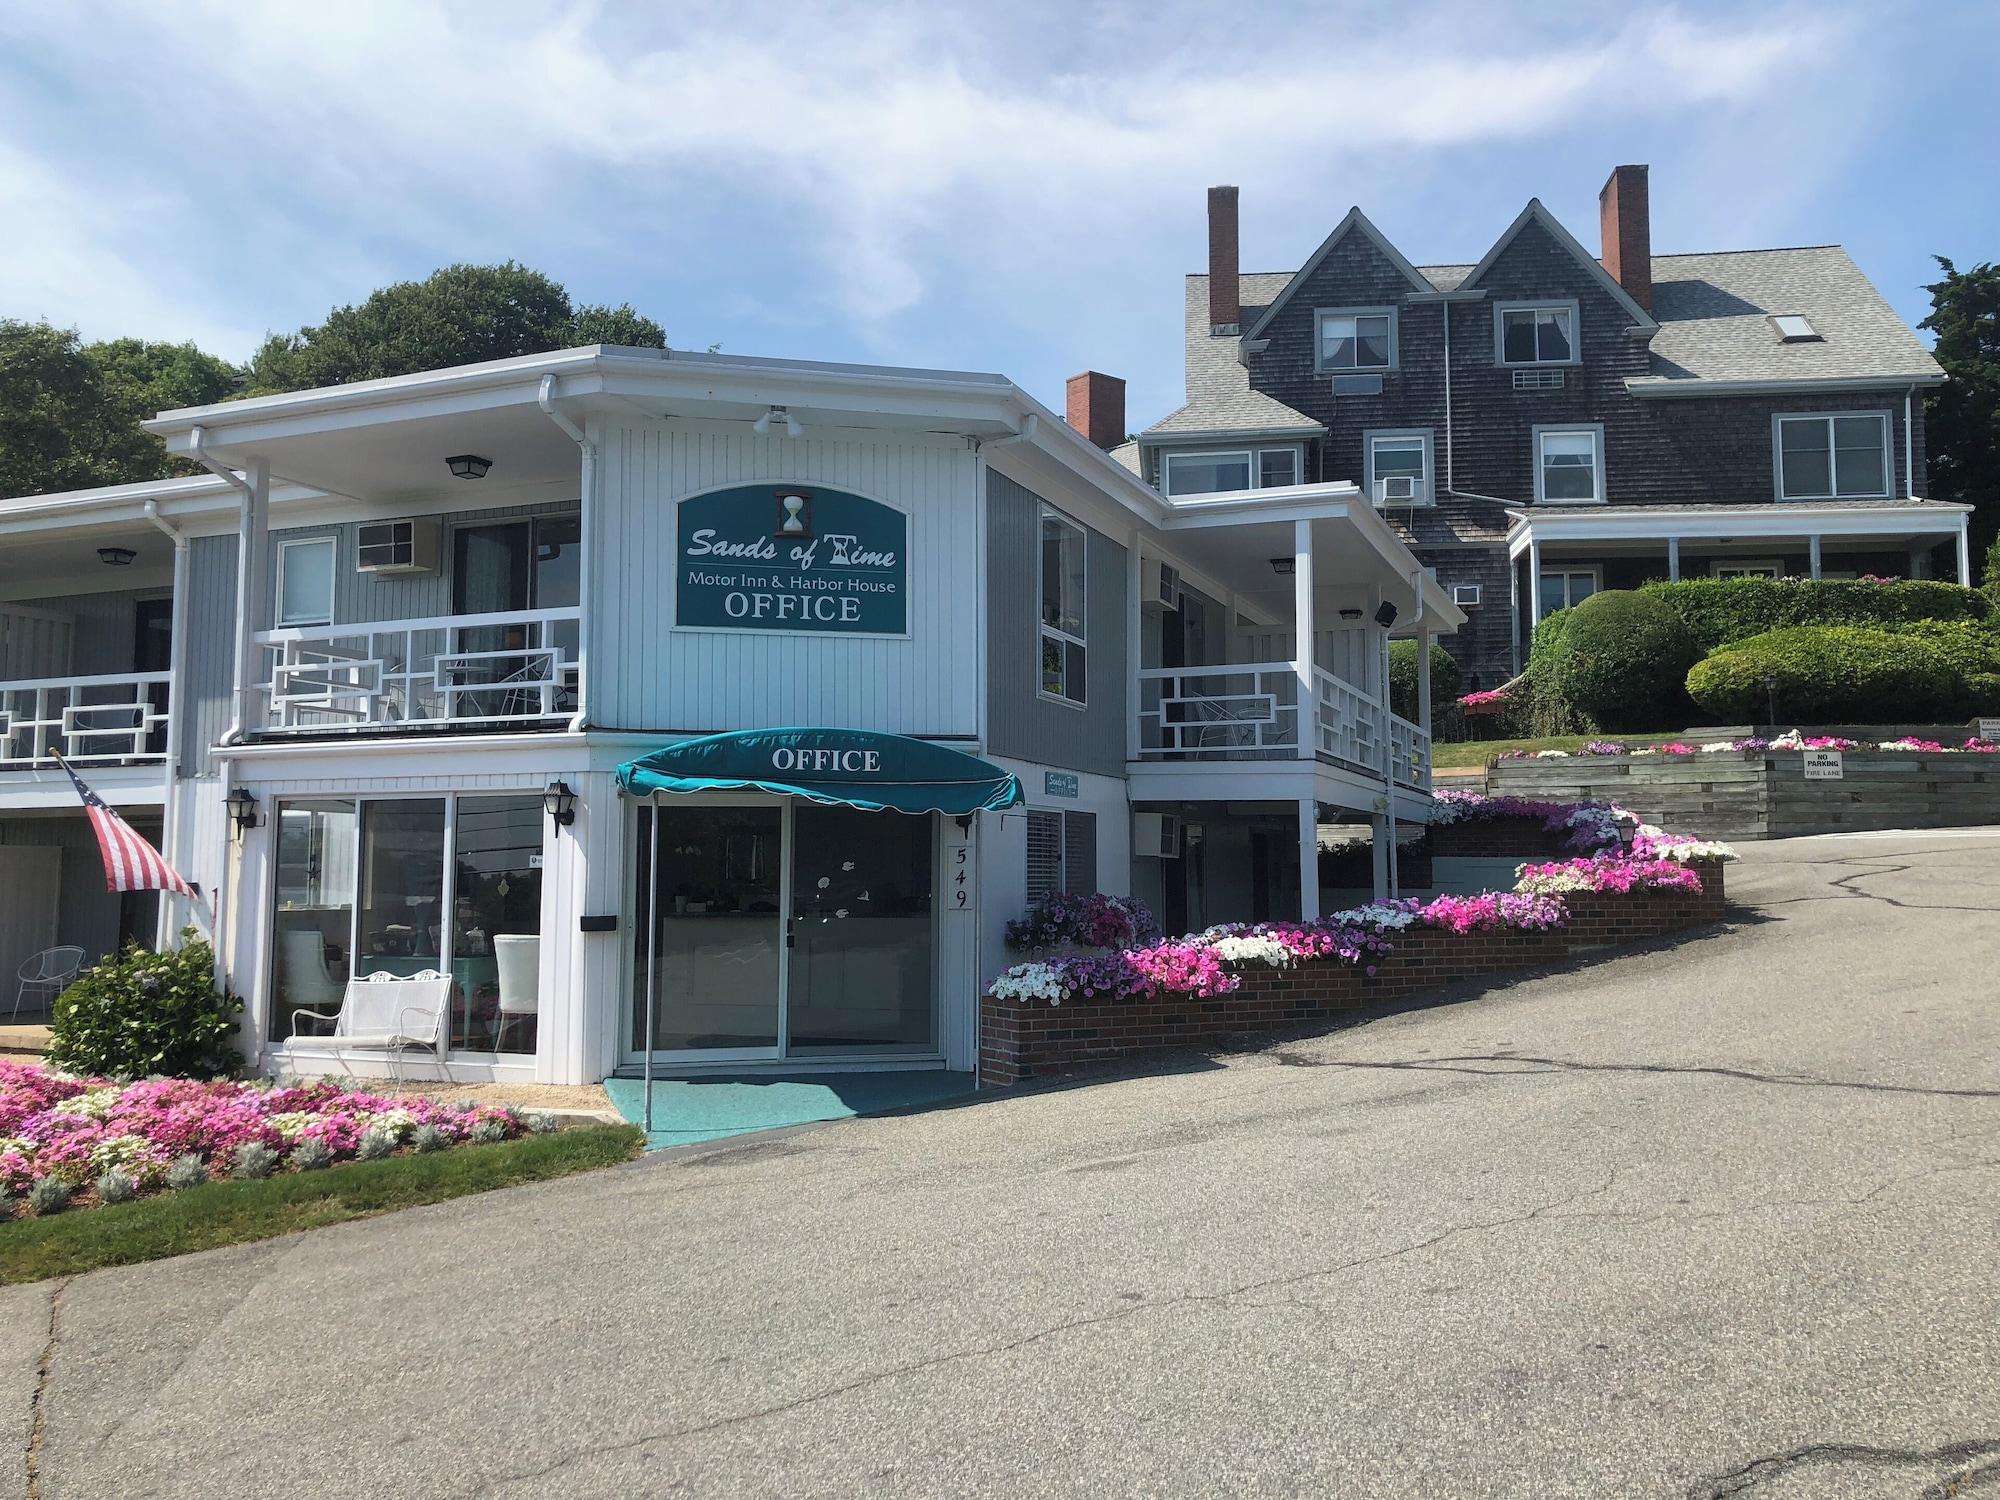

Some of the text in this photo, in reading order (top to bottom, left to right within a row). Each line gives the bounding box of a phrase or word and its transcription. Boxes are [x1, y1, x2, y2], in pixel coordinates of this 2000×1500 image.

[687, 529, 896, 570] Sands of Time
[687, 571, 896, 593] Motor Inn & Harbor House
[724, 592, 861, 622] OFFICE
[772, 748, 881, 772] OFFICE
